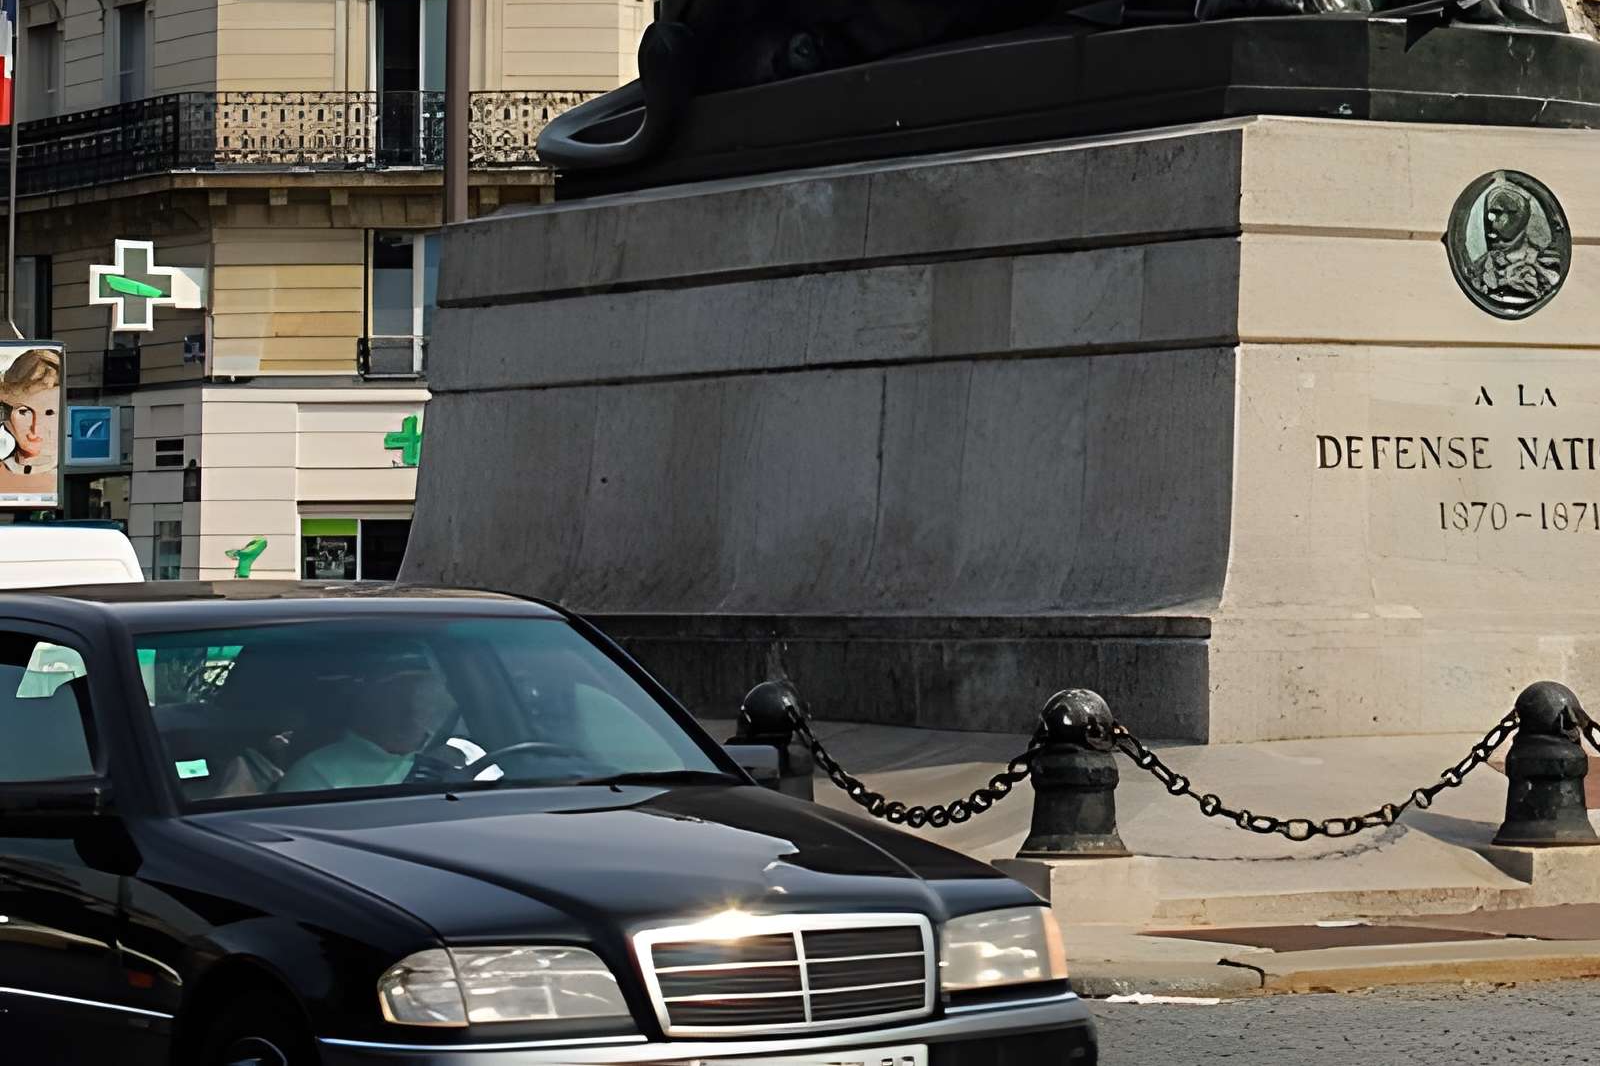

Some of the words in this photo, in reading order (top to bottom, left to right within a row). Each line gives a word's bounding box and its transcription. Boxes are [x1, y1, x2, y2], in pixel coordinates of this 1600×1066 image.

[1474, 385, 1494, 407] A
[1518, 383, 1558, 407] LA
[1316, 434, 1493, 470] DEFENSE
